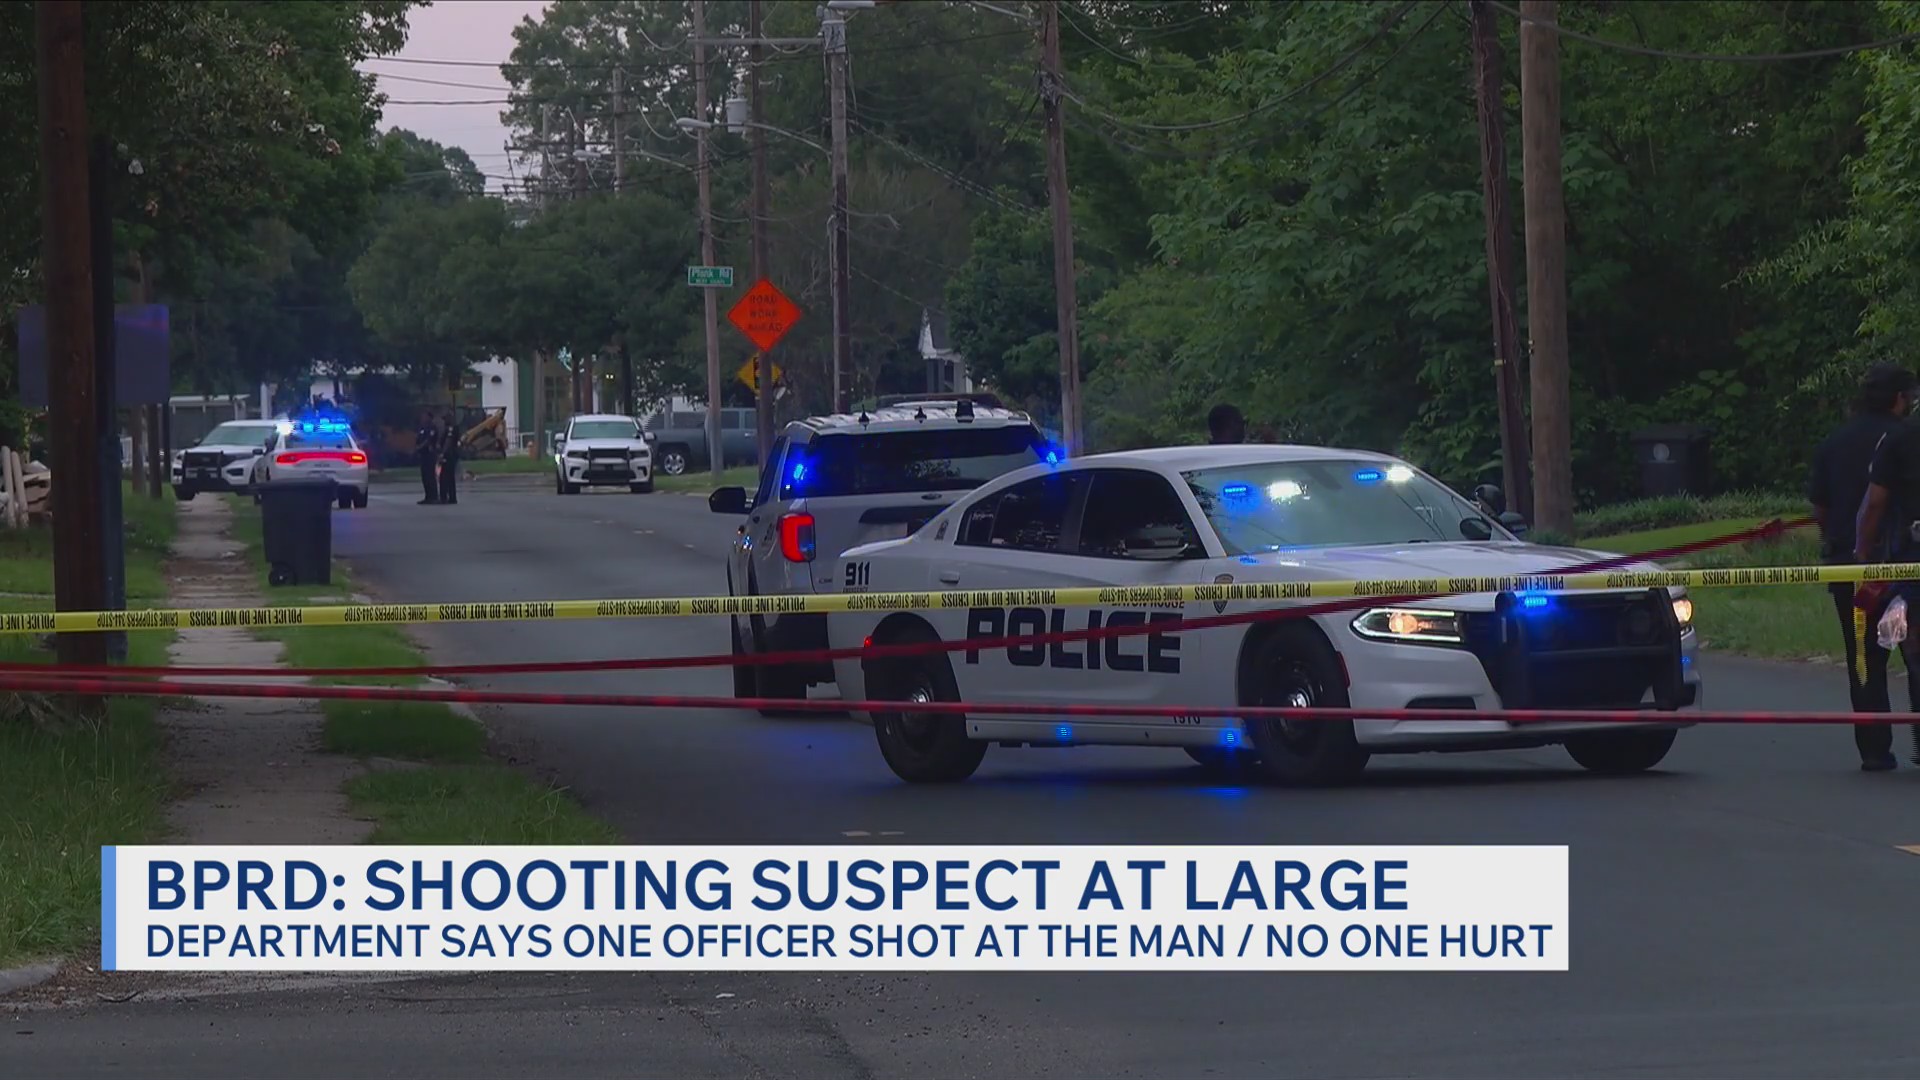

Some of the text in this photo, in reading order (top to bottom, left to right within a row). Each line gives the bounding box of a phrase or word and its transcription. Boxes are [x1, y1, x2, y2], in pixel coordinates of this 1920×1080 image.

[720, 267, 730, 278] Rd
[845, 561, 870, 586] 911
[1638, 573, 1669, 587] STOPPERS
[1672, 573, 1690, 586] CRIME
[1703, 569, 1819, 586] POLICE LINE DO NOT CROSS
[1195, 583, 1310, 600] POLICE LINE DO NOT CROSS
[1385, 580, 1416, 594] STOPPERS
[1418, 580, 1437, 593] CRIME
[1449, 576, 1563, 593] POLICE LINE DO NOT CROSS
[911, 594, 929, 607] CRIME
[942, 590, 1055, 607] POLICE LINE DO NOT CROSS
[1130, 587, 1161, 601] STOPPERS
[1164, 587, 1182, 600] CRIME
[628, 601, 659, 614] STOPPERS
[661, 601, 680, 614] CRIME
[692, 597, 804, 614] POLICE LINE DO NOT CROSS
[878, 594, 909, 608] STOPPERS
[160, 612, 178, 625] CRIME
[190, 610, 302, 626] POLICE LINE DO NOT CROSS
[375, 607, 406, 621] STOPPERS
[408, 607, 427, 620] CRIME
[440, 604, 553, 620] POLICE LINE DO NOT CROSS
[6, 615, 24, 628] LINE
[27, 614, 55, 628] POLICE
[127, 613, 157, 626] STOPPERS
[966, 608, 1183, 674] POLICE
